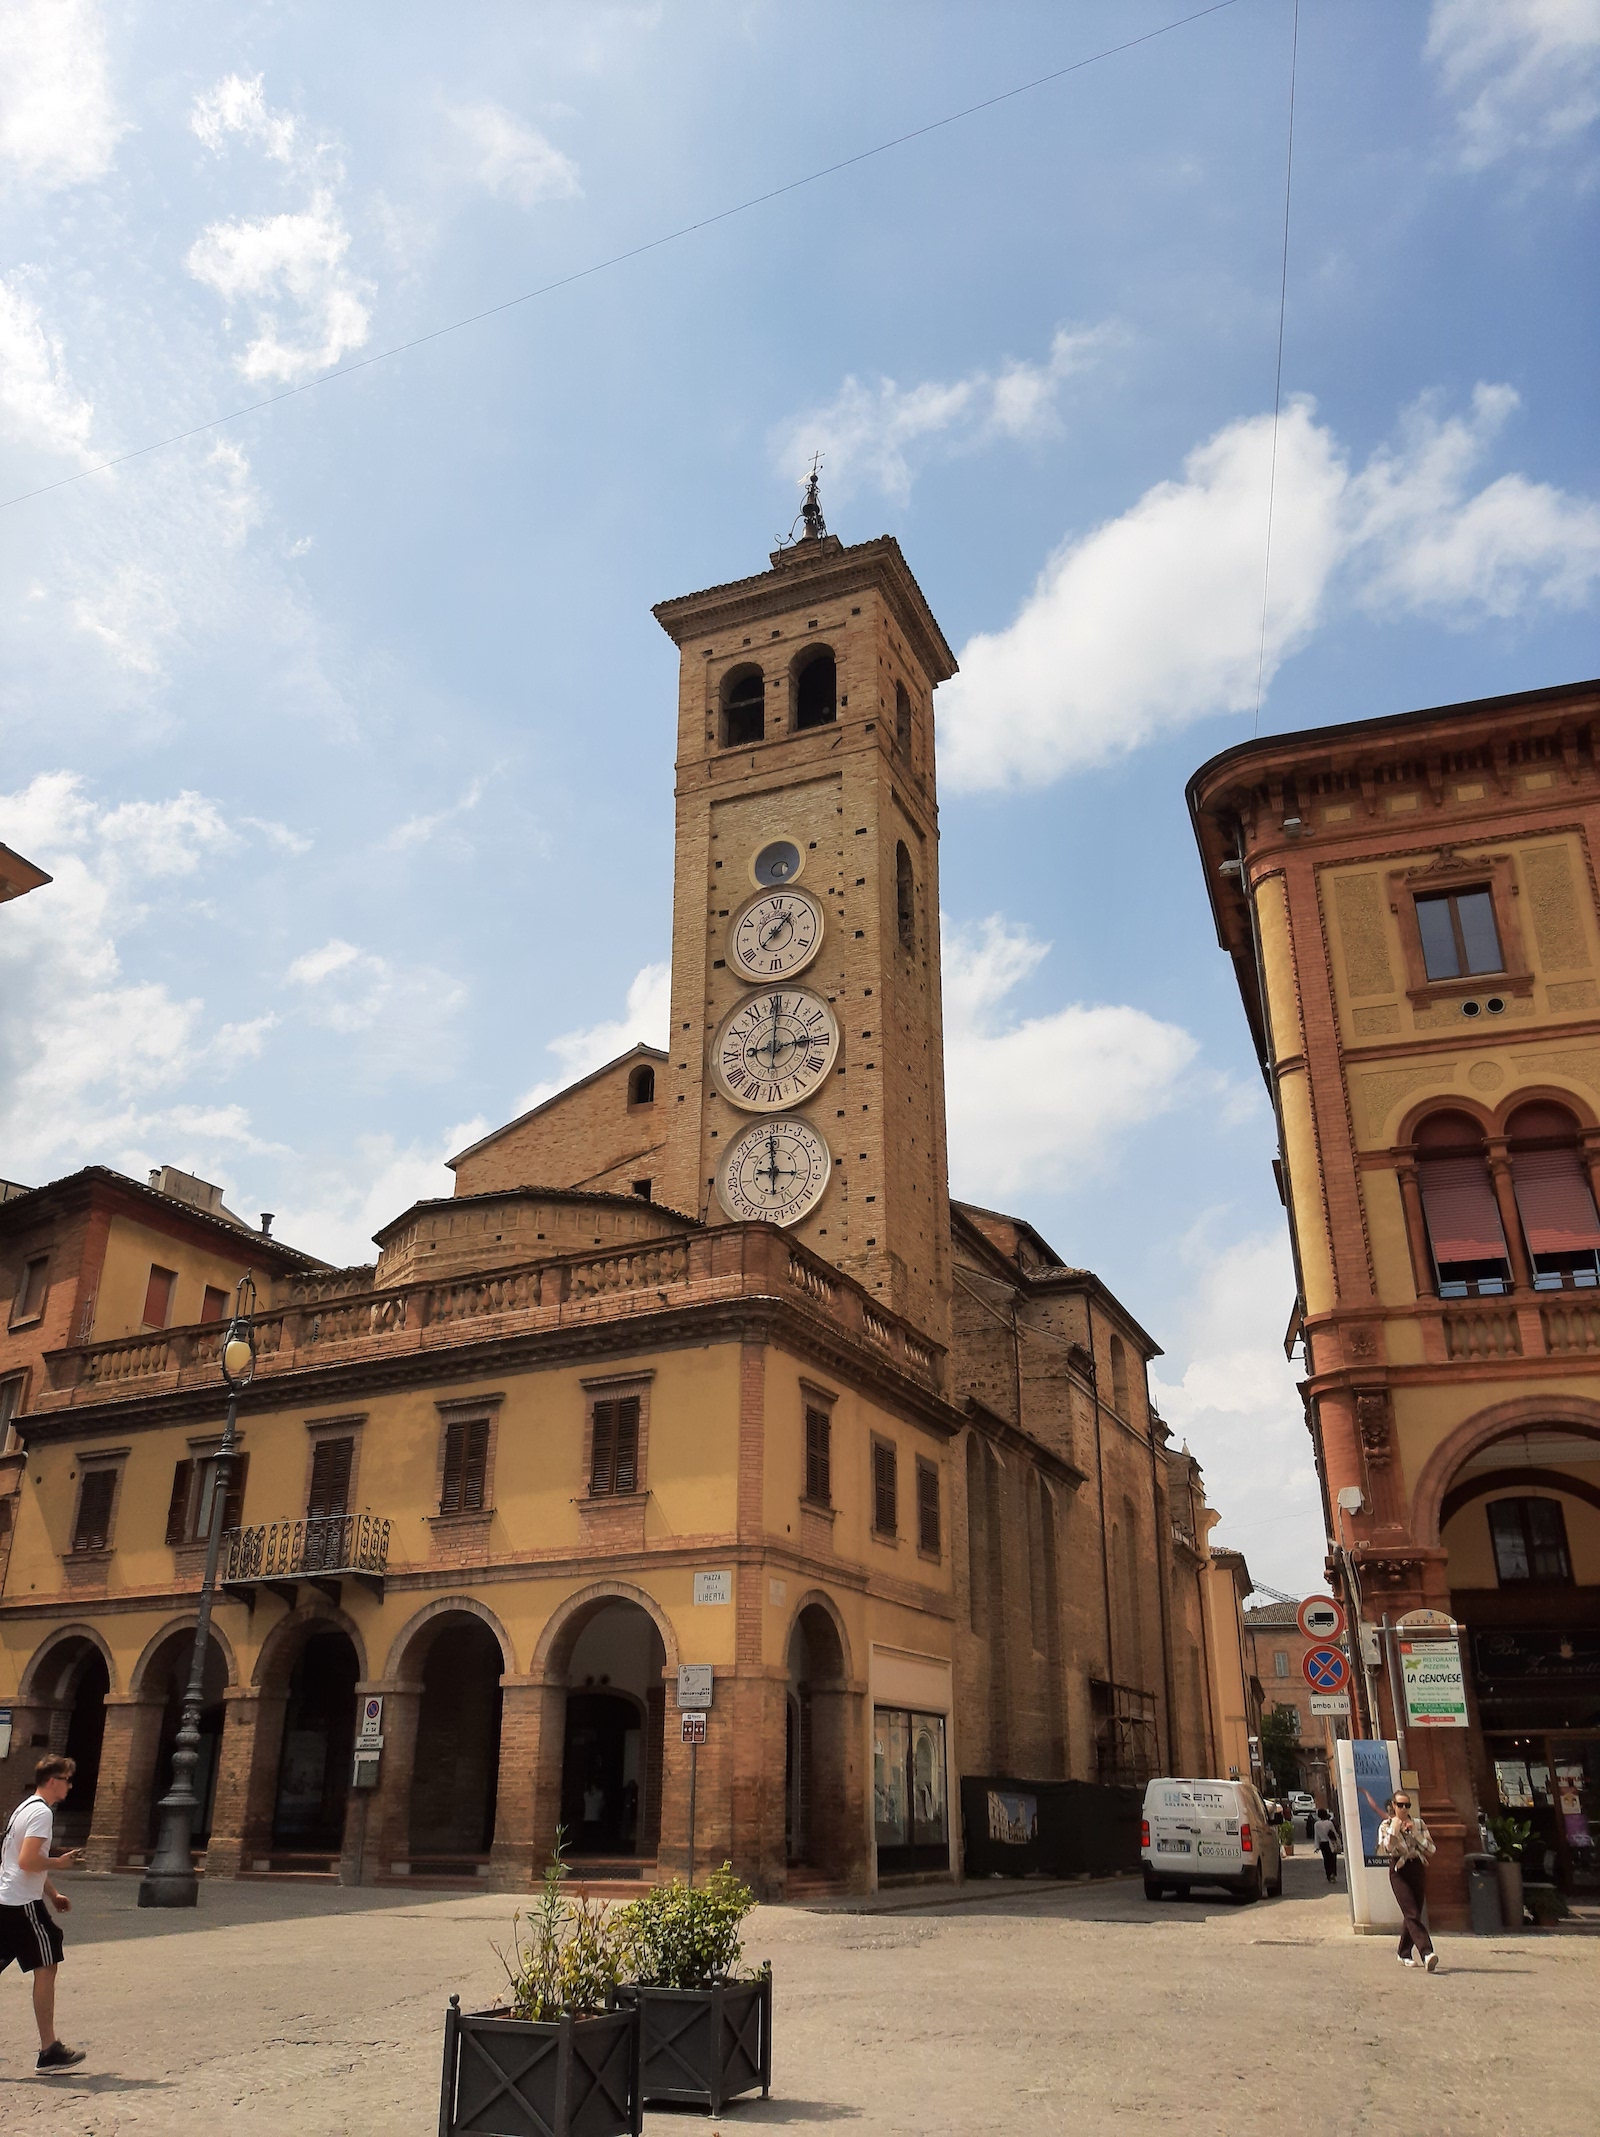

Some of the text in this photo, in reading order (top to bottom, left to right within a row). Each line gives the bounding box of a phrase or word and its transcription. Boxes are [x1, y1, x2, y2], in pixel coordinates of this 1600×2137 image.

[770, 899, 783, 910] VI
[743, 919, 754, 928] V
[797, 938, 809, 947] II
[742, 948, 757, 963] IIII
[769, 958, 782, 970] III
[744, 1004, 762, 1023] XI
[806, 1010, 824, 1026] II
[728, 1026, 746, 1040] X
[757, 1023, 768, 1033] 23
[748, 1034, 759, 1045] 22
[813, 1032, 830, 1046] III
[723, 1050, 739, 1065] IX
[806, 1055, 825, 1074] IIII
[792, 1075, 807, 1093] V
[767, 1085, 783, 1102] VI
[751, 1129, 764, 1141] 29
[769, 1124, 779, 1134] 31
[793, 1127, 803, 1137] 3
[737, 1141, 750, 1156] 27
[805, 1139, 817, 1148] 5
[747, 1152, 759, 1164] S
[729, 1160, 741, 1173] 25
[728, 1177, 738, 1191] 23
[732, 1193, 744, 1206] 21
[802, 1189, 814, 1200] 11
[742, 1204, 754, 1217] 19
[788, 1201, 802, 1214] 13
[756, 1210, 768, 1221] 17
[773, 1209, 785, 1221] 15
[698, 1591, 725, 1602] LIBERTÀ
[1407, 1673, 1462, 1684] LA GENOVESE
[1338, 1701, 1349, 1709] lati
